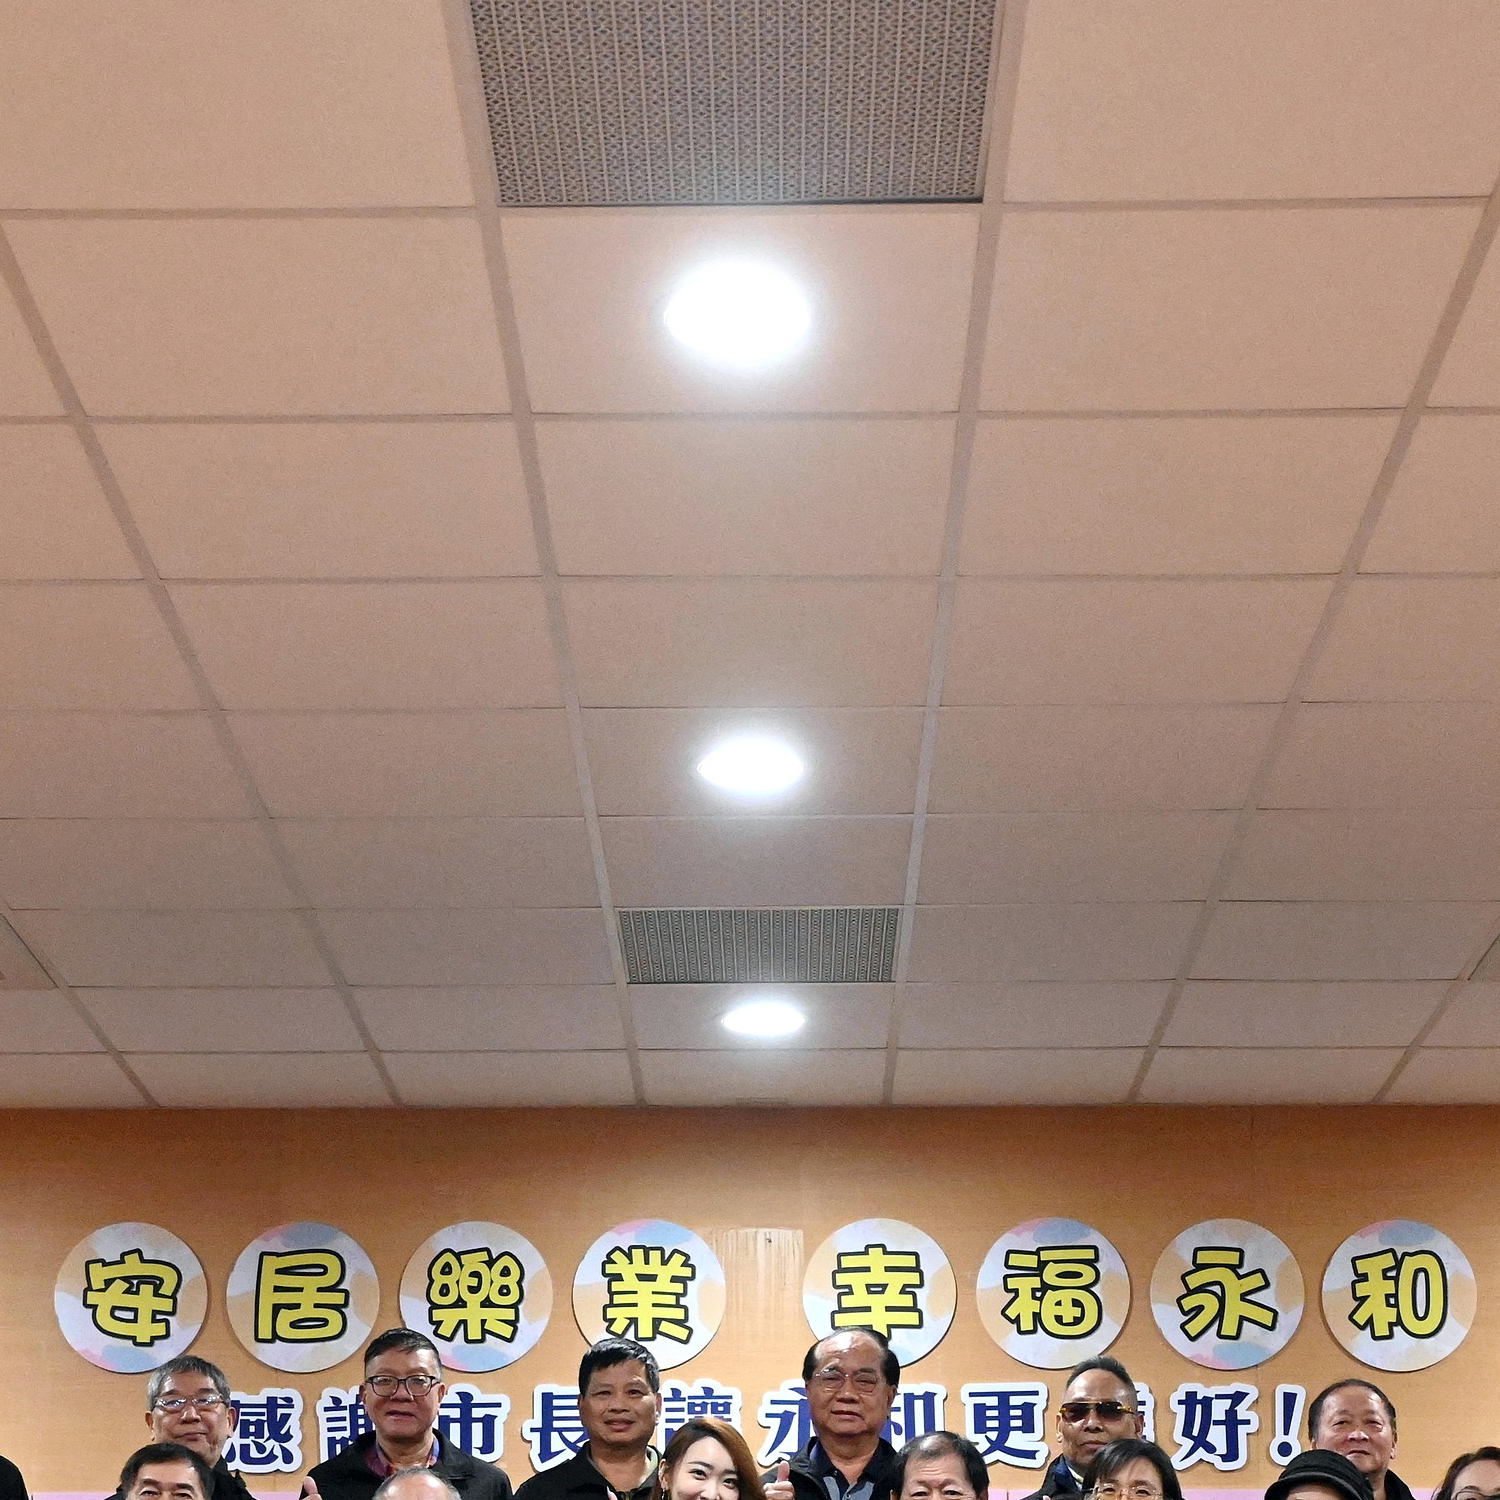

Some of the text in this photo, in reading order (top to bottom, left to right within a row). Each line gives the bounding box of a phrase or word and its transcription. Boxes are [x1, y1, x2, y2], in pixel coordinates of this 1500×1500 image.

[84, 1247, 1449, 1345] 安居樂業 幸福永和
